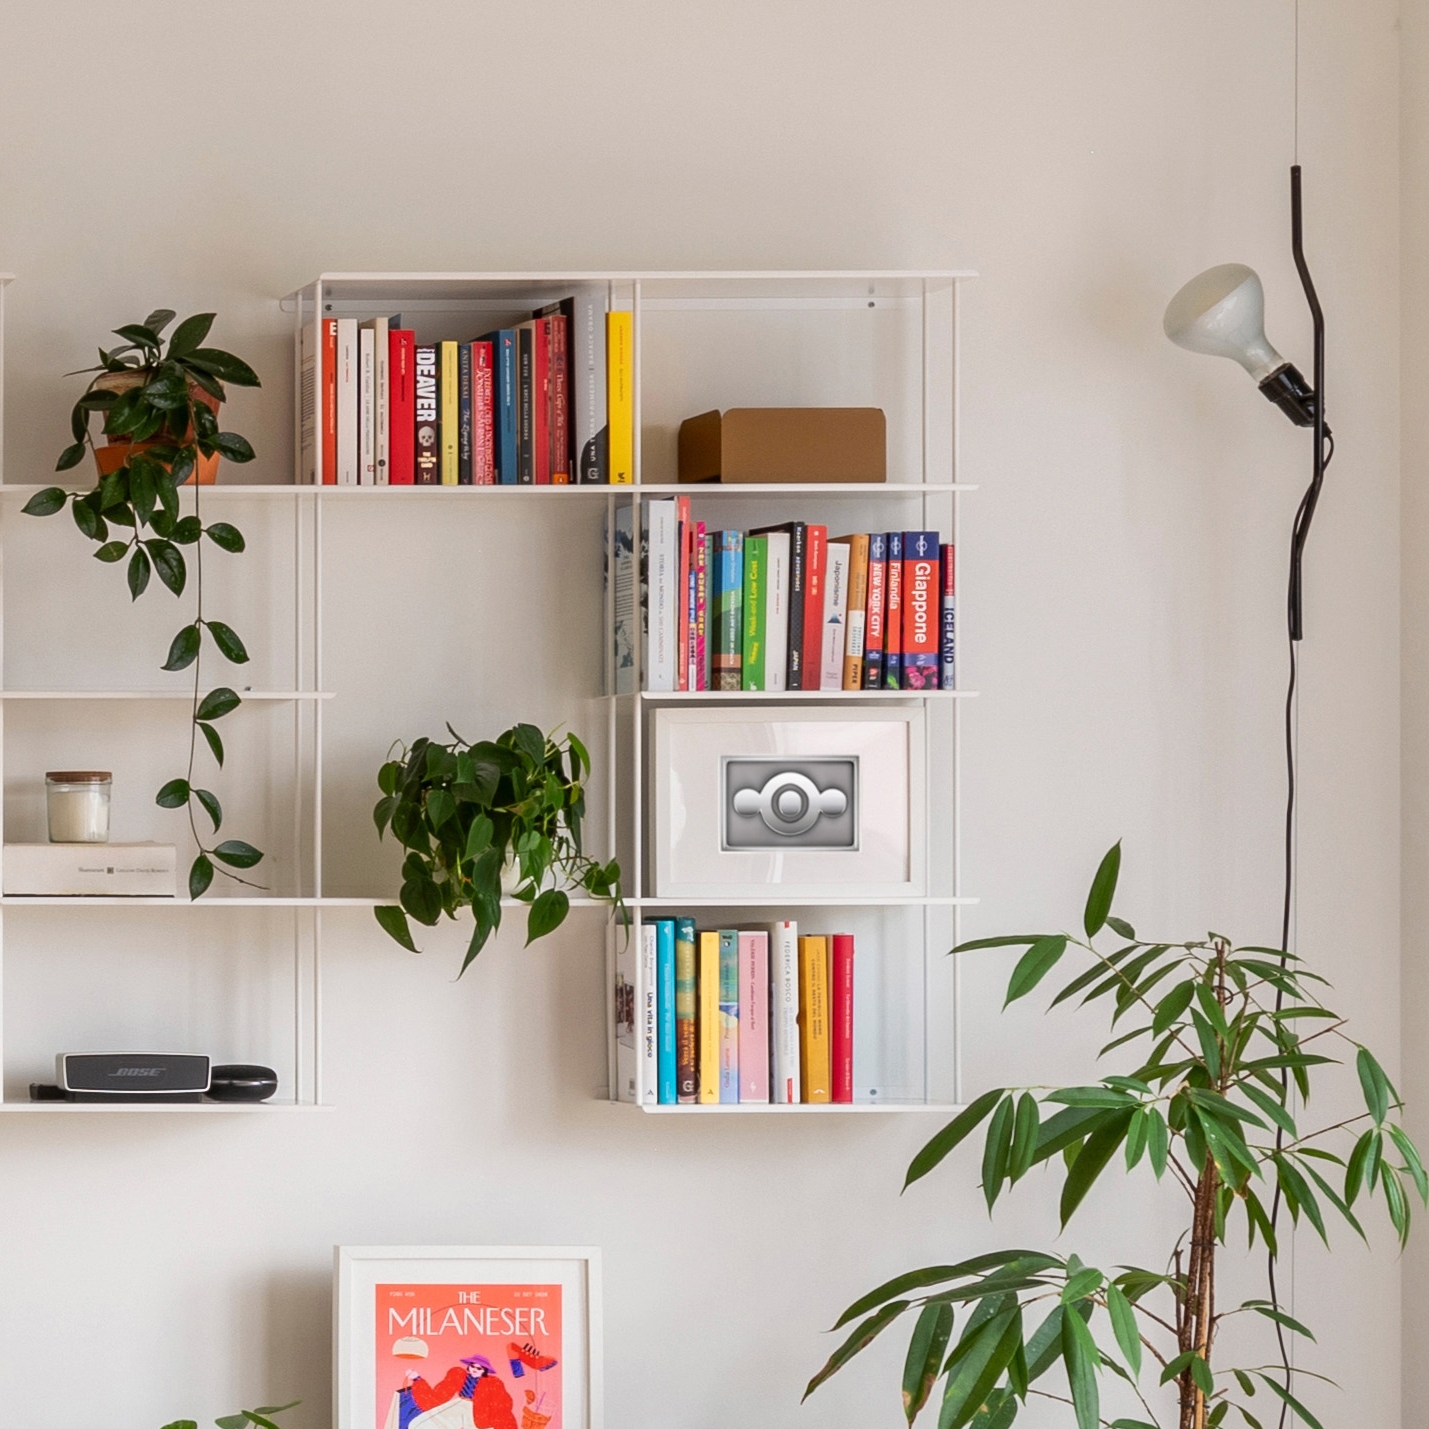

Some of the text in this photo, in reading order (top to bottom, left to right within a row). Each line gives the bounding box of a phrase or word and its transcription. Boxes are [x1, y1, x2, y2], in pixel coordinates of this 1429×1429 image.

[416, 353, 436, 421] DEAVER
[556, 373, 564, 392] Three
[484, 406, 492, 424] LOUD
[750, 561, 758, 580] Cost
[832, 560, 842, 606] Japonisme
[749, 582, 757, 599] Low
[871, 563, 882, 637] NEW YORK CITY
[890, 562, 900, 609] Finlandia
[911, 562, 931, 643] Giappone
[944, 608, 954, 664] ICELAND
[108, 1067, 166, 1077] BOSE
[457, 1291, 481, 1304] THE
[388, 1307, 549, 1336] MILANESER
